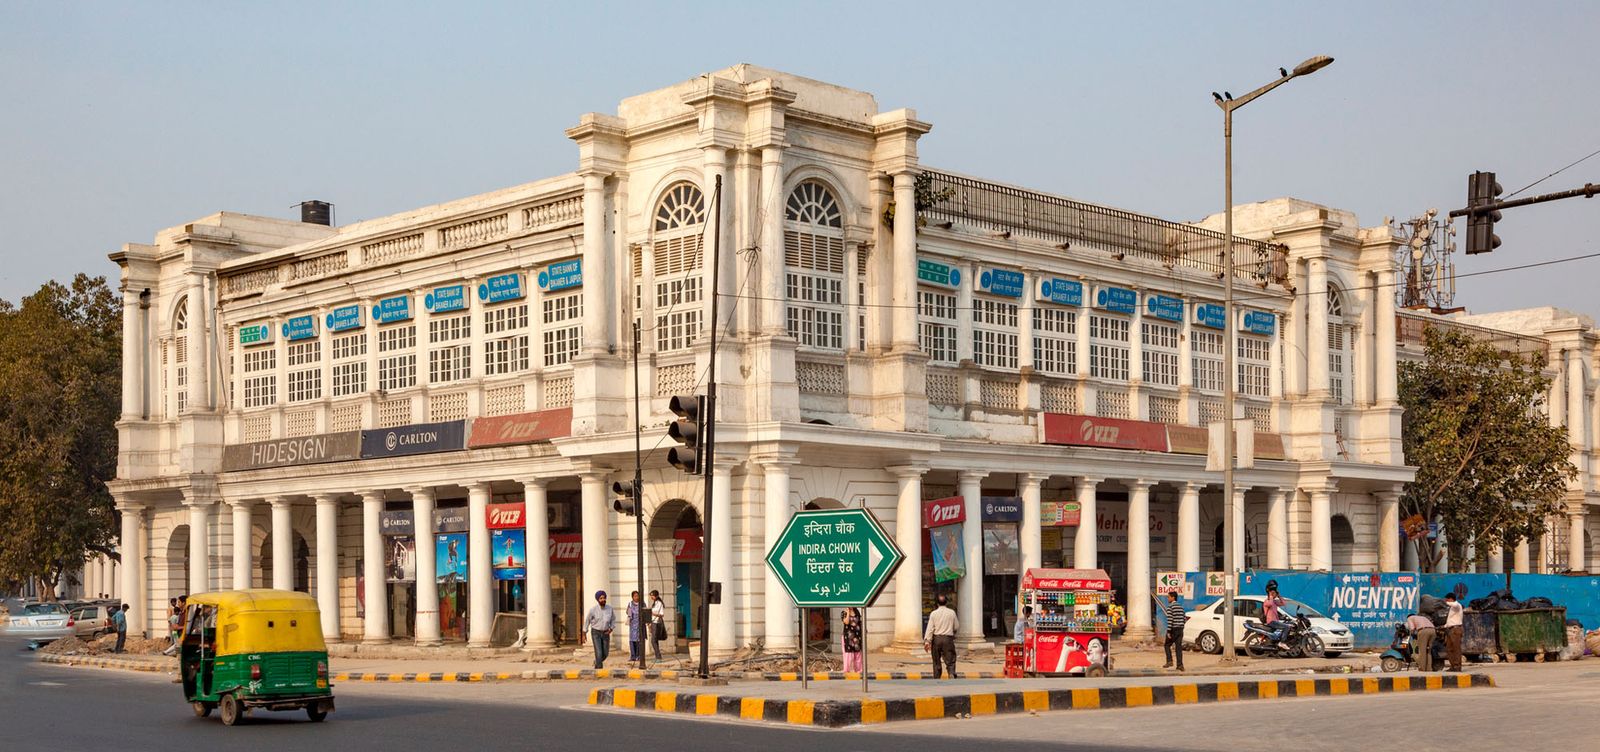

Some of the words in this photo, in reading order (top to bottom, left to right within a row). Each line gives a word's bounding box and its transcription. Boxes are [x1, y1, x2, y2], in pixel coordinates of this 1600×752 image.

[400, 431, 438, 445] CARLTON
[1094, 425, 1119, 443] VIP
[251, 437, 327, 465] HIDESIGN
[941, 504, 961, 521] VIP
[994, 505, 1018, 513] CARLTON
[443, 516, 464, 524] CARLTON
[500, 510, 521, 524] VIP
[1096, 513, 1129, 530] Mehr
[803, 520, 832, 538] इन्दिरा
[835, 518, 855, 534] चौक
[799, 543, 826, 555] INDIRA
[828, 542, 861, 554] CHOWK
[833, 582, 850, 596] اندرا
[1158, 586, 1183, 594] BLOCK
[1332, 586, 1356, 609] NO
[1357, 586, 1417, 610] ENTRY
[1038, 635, 1058, 643] Coca-Cola
